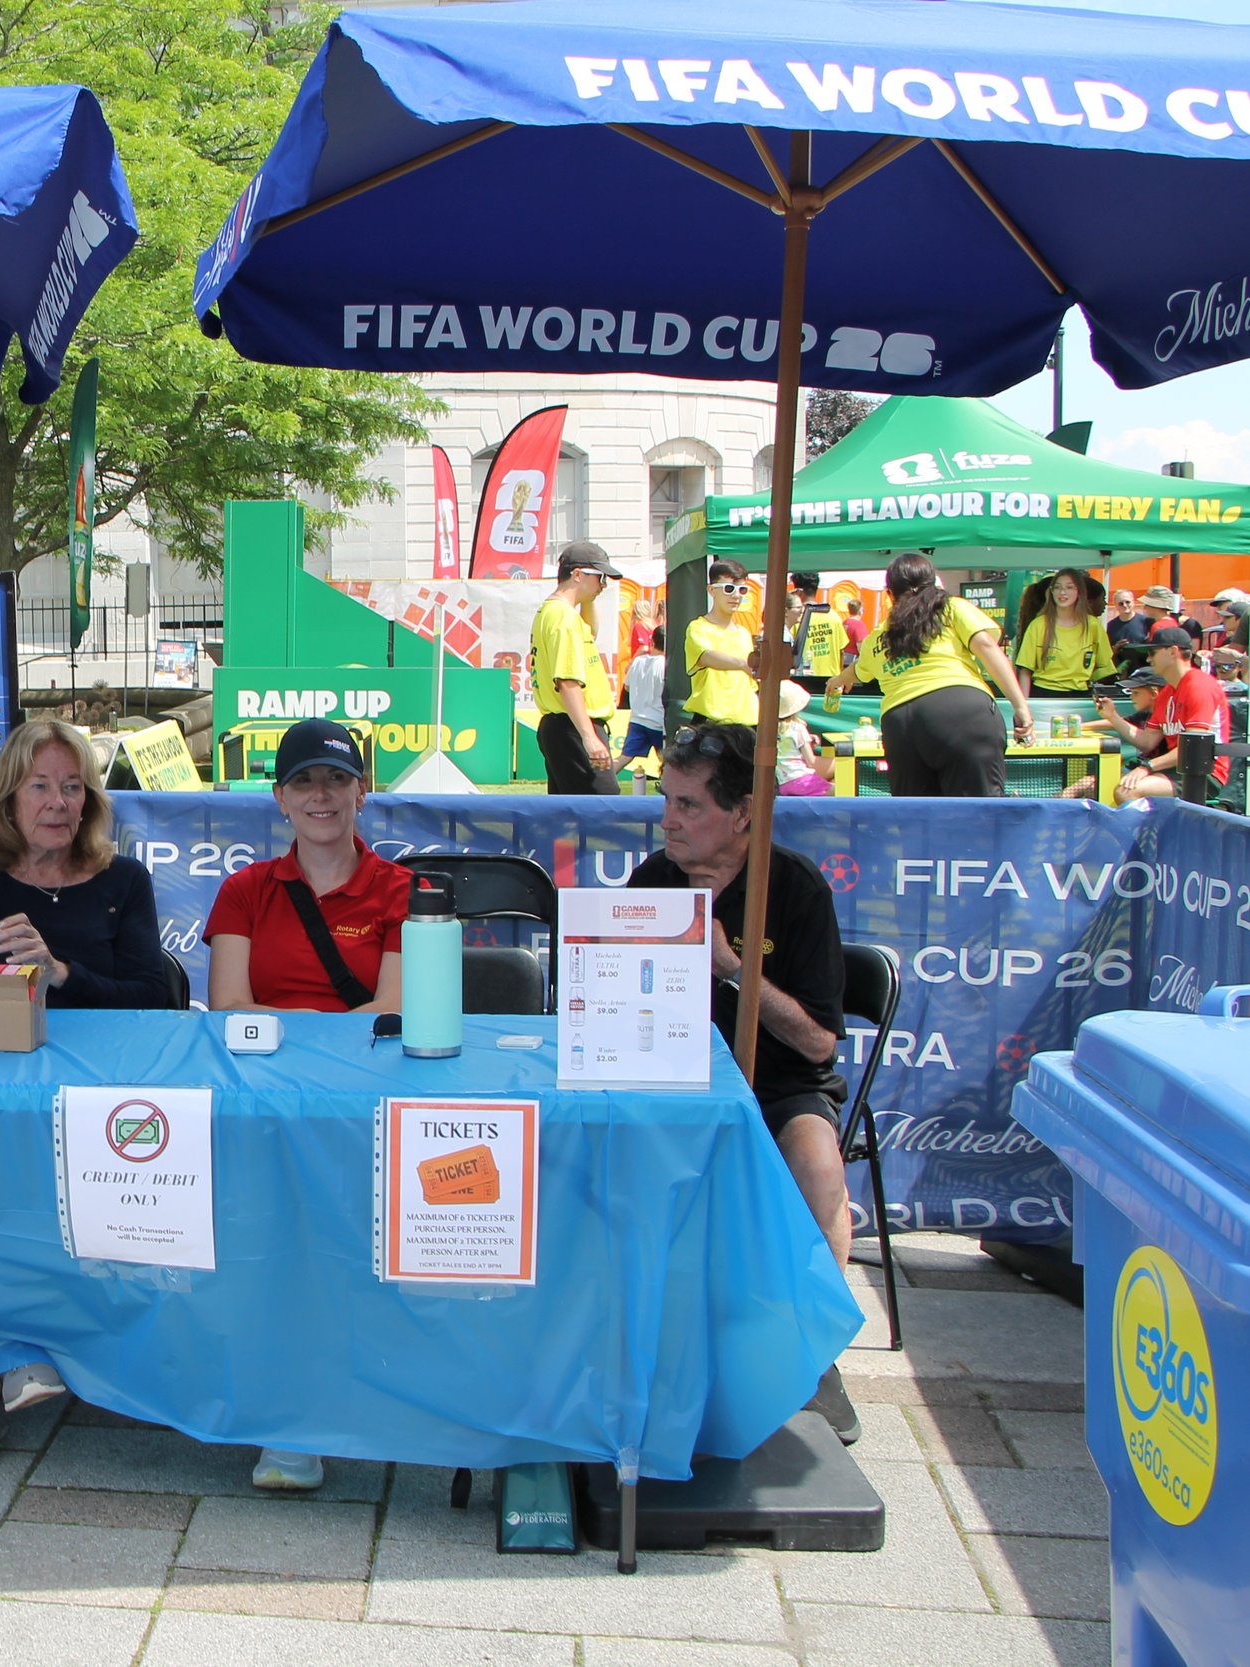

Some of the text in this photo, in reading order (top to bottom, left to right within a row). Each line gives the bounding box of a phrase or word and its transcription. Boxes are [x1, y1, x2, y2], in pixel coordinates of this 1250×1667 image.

[565, 56, 785, 110] FIFA
[786, 62, 1148, 134] WORLD
[343, 305, 467, 349] FIFA
[479, 306, 691, 356] WORLD
[825, 326, 936, 376] 26
[791, 500, 842, 525] THE
[847, 491, 984, 522] FLAVOUR
[990, 491, 1050, 519] FOR
[1057, 495, 1153, 521] EVERY
[503, 535, 525, 546] FIFA
[965, 588, 994, 599] RAMP
[980, 598, 997, 608] THE
[807, 629, 833, 638] LAVOUR
[238, 690, 391, 718] RAMP UP
[895, 859, 1029, 899] FIFA
[1182, 871, 1231, 919] CUP
[336, 924, 360, 934] Rotary
[913, 946, 1132, 987] CUP 26
[597, 970, 618, 978] $8.00
[665, 985, 686, 993] $5.00
[597, 1007, 618, 1015] $9.00
[667, 1031, 689, 1039] $9.00
[596, 1055, 617, 1063] $2.00
[420, 1121, 499, 1140] TICKETS
[435, 1159, 479, 1183] TICKET
[82, 1170, 139, 1185] CREDIT
[152, 1174, 199, 1187] DEBIT
[120, 1193, 161, 1207] ONLY
[406, 1213, 448, 1221] MAXIMUM
[449, 1213, 459, 1221] OF
[467, 1214, 499, 1222] TICKETS
[500, 1214, 515, 1222] PER
[848, 1197, 998, 1231] ORLD
[119, 1225, 137, 1233] Cash
[138, 1226, 184, 1236] Transactions
[414, 1225, 507, 1234] PURCHASE PER PERSON.
[131, 1234, 141, 1242] be
[143, 1236, 175, 1244] accepted
[406, 1237, 448, 1245] MAXIMUM
[449, 1237, 459, 1245] OF
[466, 1237, 498, 1245] TICKETS
[499, 1237, 514, 1245] PER
[421, 1248, 452, 1256] PERSON
[454, 1249, 479, 1257] AFTER
[1135, 1323, 1210, 1424] E360S
[1129, 1430, 1192, 1510] e360s.ca
[520, 1515, 568, 1524] FEDERATION
